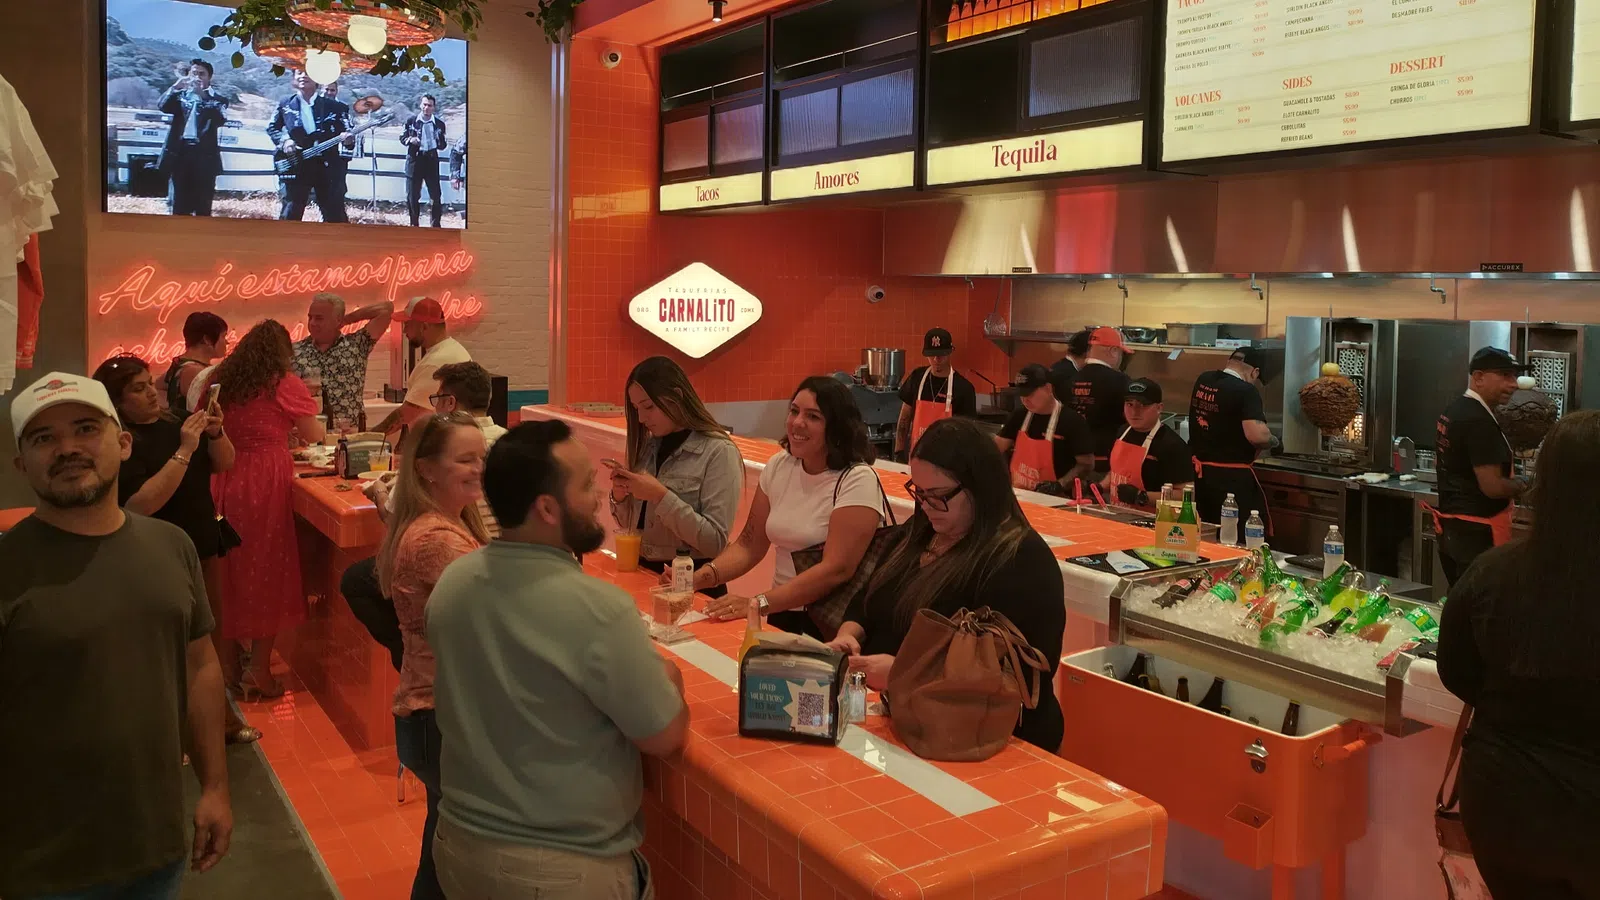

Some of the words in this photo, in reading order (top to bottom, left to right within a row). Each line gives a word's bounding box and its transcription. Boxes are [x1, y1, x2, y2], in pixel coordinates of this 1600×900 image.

[1392, 9, 1418, 18] DESMADRE
[1390, 55, 1446, 74] DESSERT
[1282, 76, 1312, 90] SIDES
[1417, 80, 1435, 89] GLORIA
[1175, 90, 1222, 107] VOLCANES
[1283, 98, 1308, 106] GUACAMOLE
[1313, 94, 1336, 102] TOSTADAS
[1389, 97, 1413, 105] CHURROS
[1296, 108, 1320, 117] CARNALITO
[1281, 123, 1306, 131] CEBOLLITAS
[992, 139, 1058, 172] Tequila
[813, 169, 860, 191] Amores
[695, 185, 720, 202] Tacos
[99, 262, 235, 325] Aquí
[236, 255, 394, 299] estamos
[388, 248, 474, 302] para
[758, 682, 776, 692] LOVED
